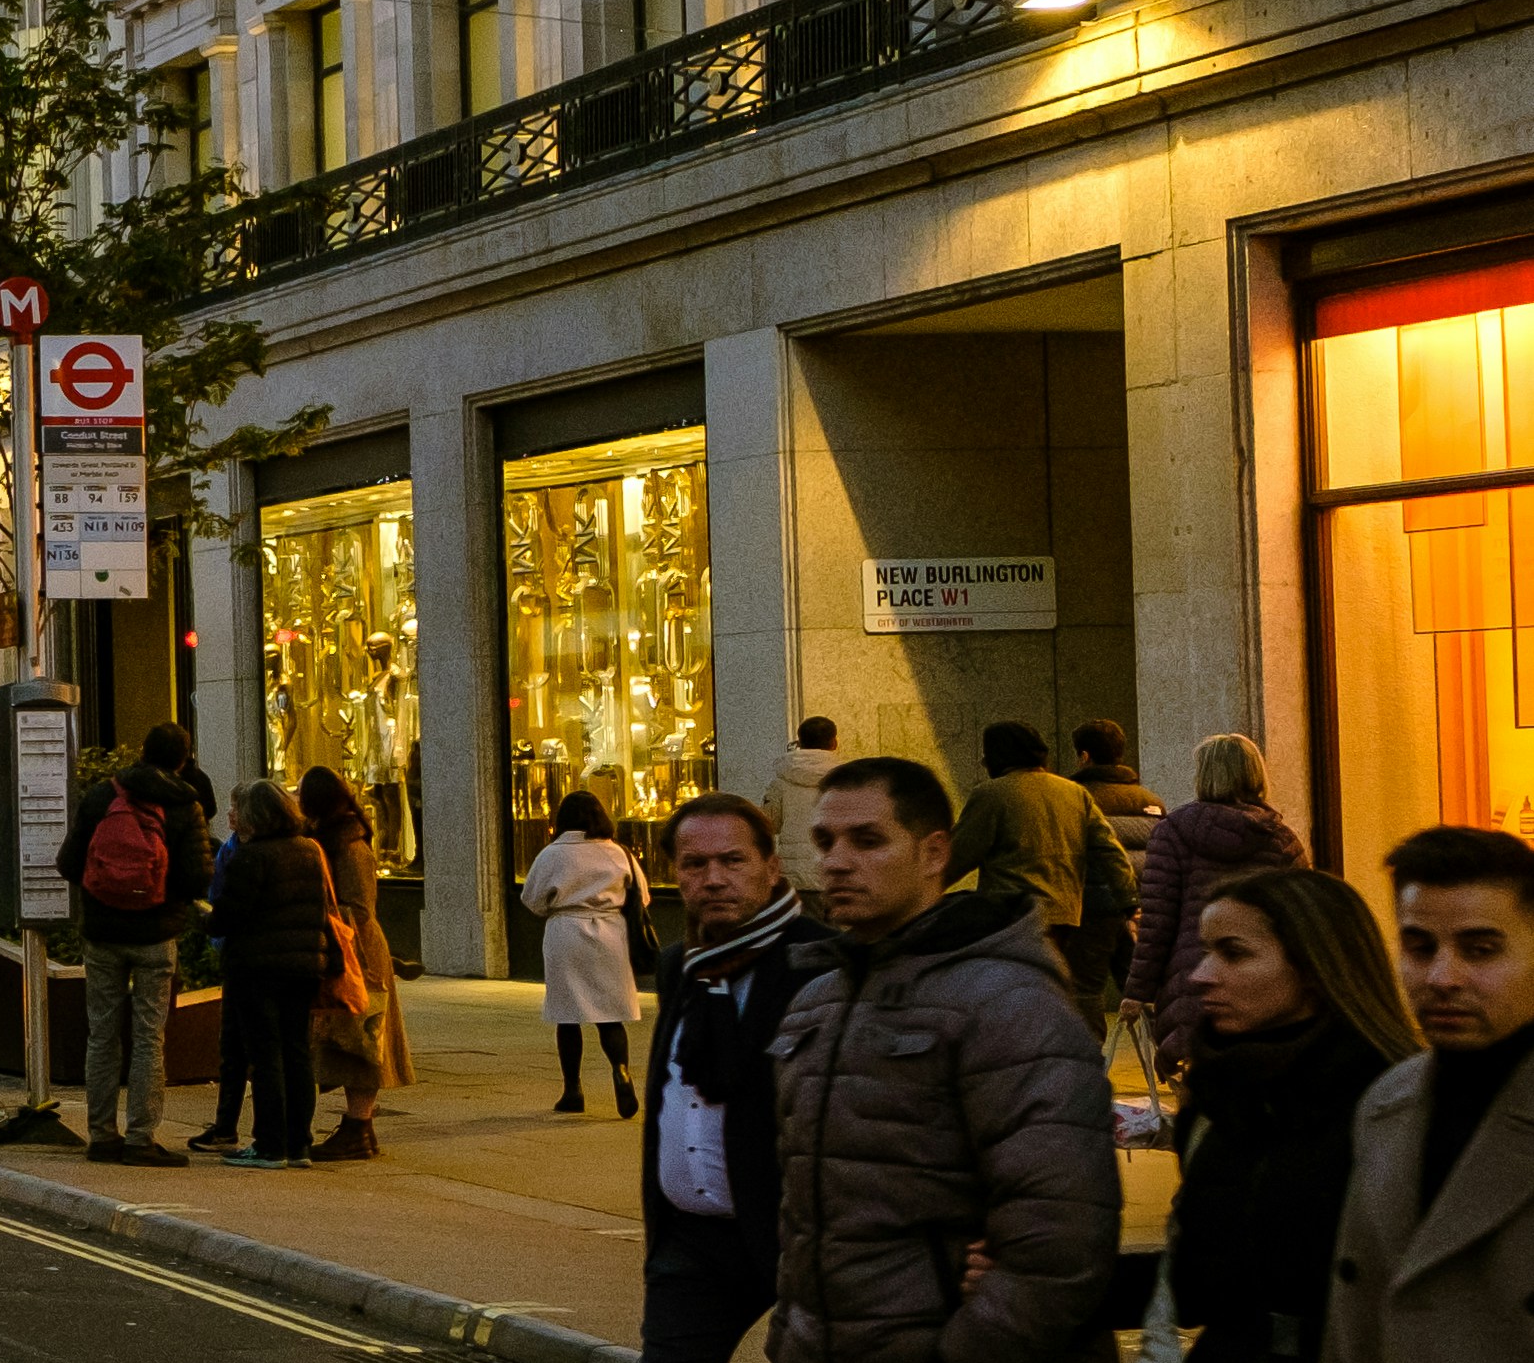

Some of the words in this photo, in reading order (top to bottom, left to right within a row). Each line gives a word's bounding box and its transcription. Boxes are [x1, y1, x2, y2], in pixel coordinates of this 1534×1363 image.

[0, 286, 41, 327] M
[100, 431, 128, 440] Street
[54, 493, 69, 504] 88
[88, 493, 103, 504] 94
[119, 493, 139, 503] 159
[51, 522, 74, 532] 453
[84, 521, 109, 532] N18
[114, 521, 145, 532] N109
[47, 549, 79, 560] N136
[876, 566, 918, 584] NEW
[925, 564, 1044, 584] BURLINGTON
[877, 588, 934, 607] PLACE
[941, 588, 969, 606] W1
[877, 618, 897, 628] CITY
[899, 618, 911, 627] OF
[913, 617, 974, 628] WESTMINSTER
